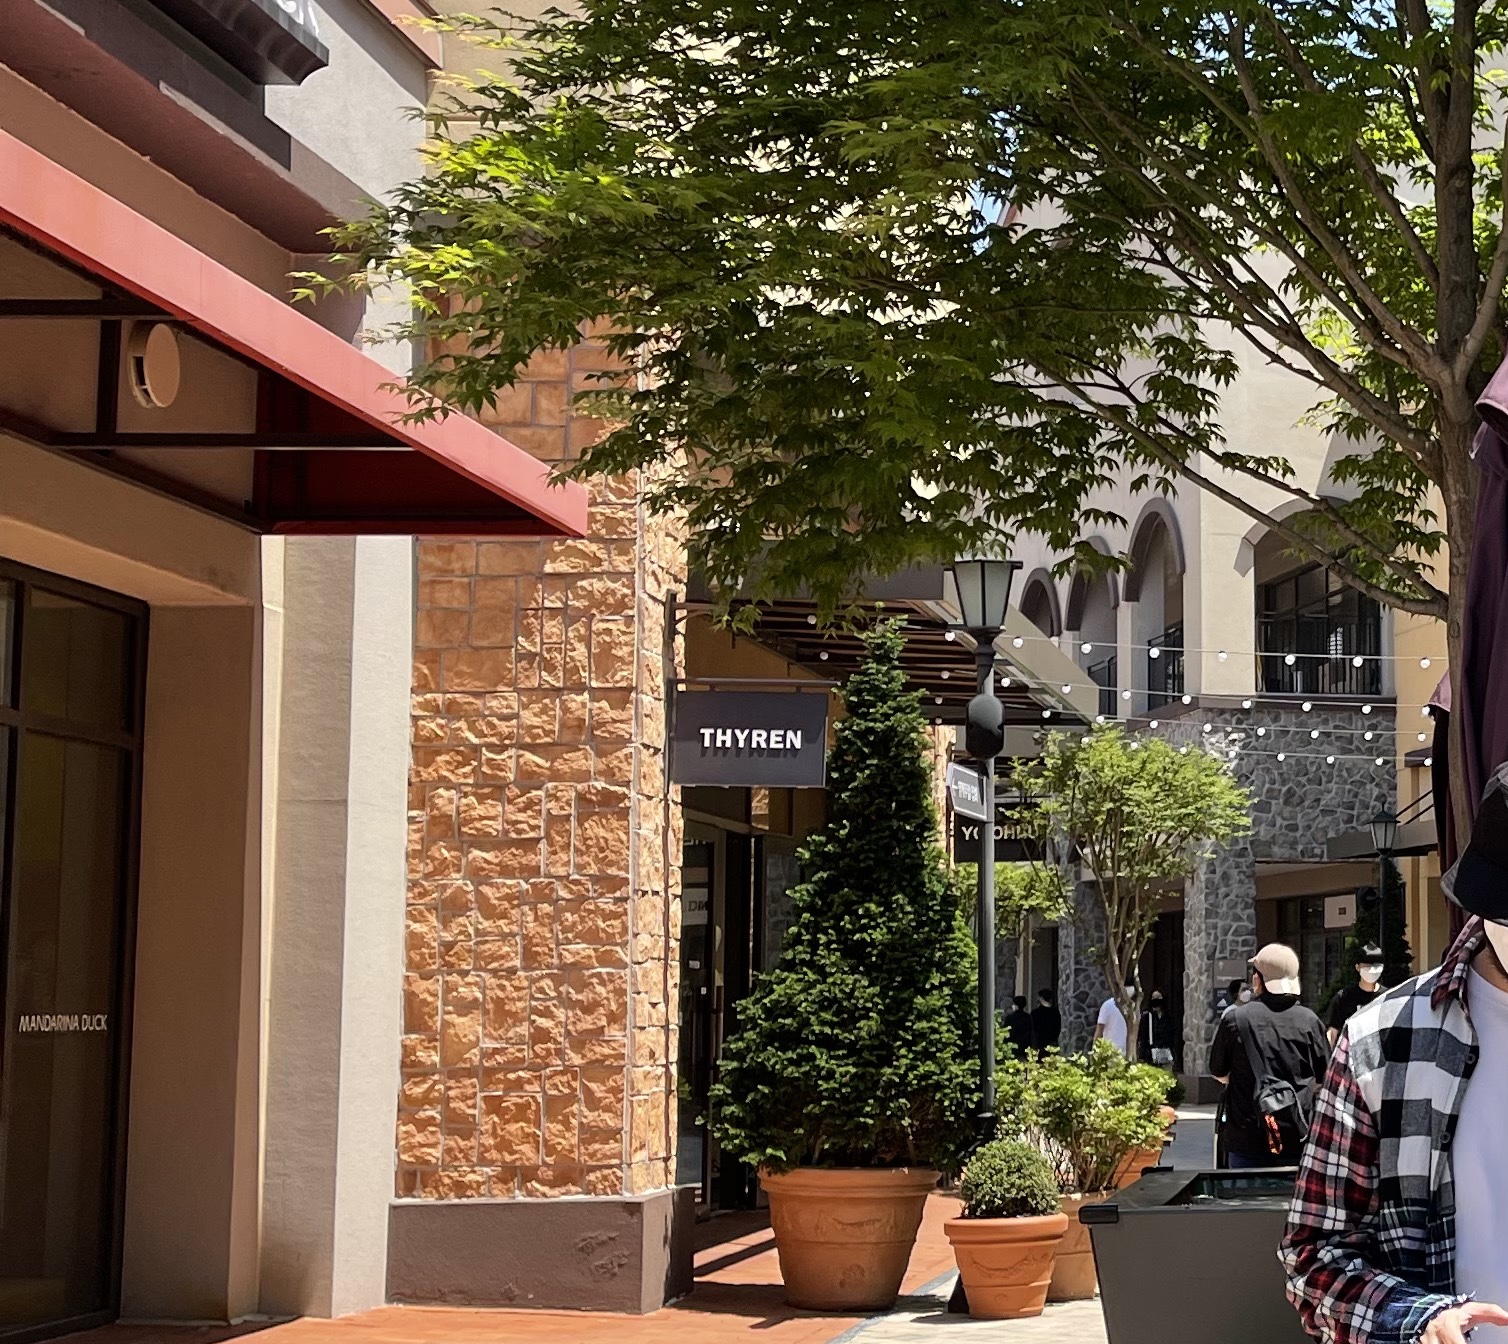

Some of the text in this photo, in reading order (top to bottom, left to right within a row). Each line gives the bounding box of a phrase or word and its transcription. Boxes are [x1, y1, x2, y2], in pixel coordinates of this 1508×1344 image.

[699, 727, 802, 749] THYREN
[19, 1014, 107, 1032] MANDARINA DUCK
